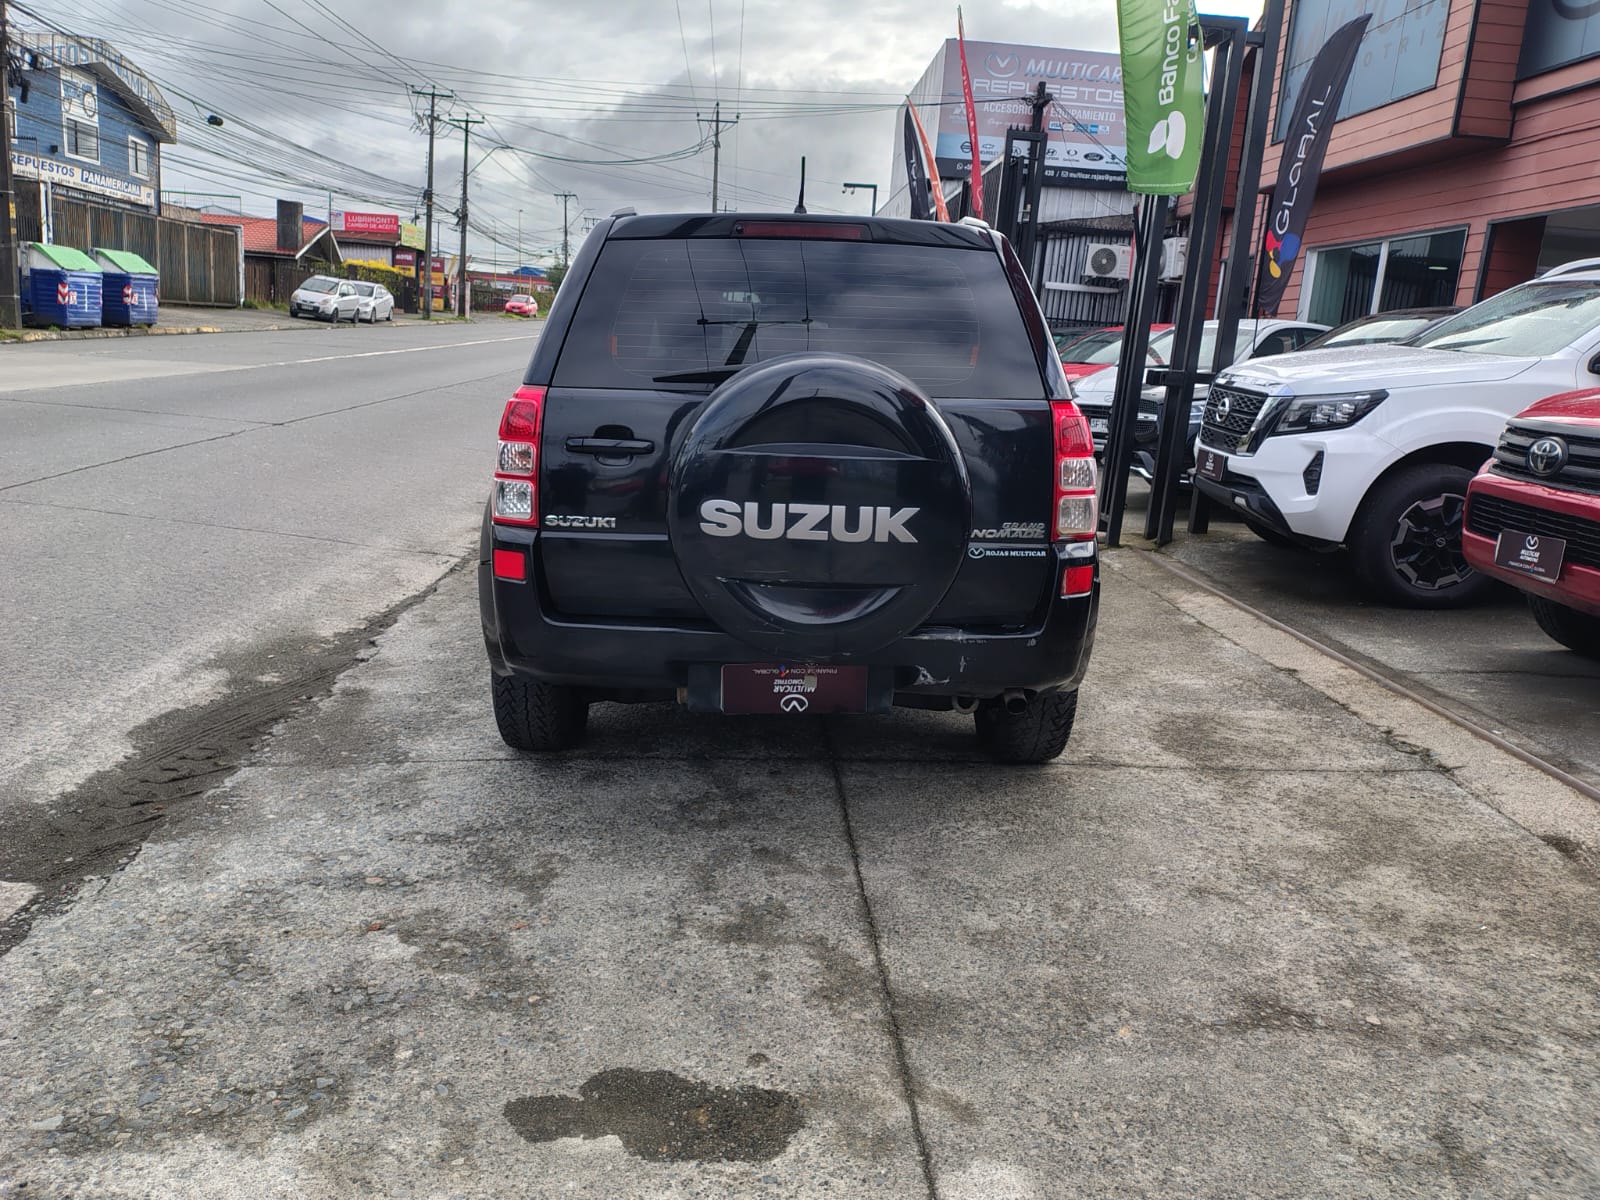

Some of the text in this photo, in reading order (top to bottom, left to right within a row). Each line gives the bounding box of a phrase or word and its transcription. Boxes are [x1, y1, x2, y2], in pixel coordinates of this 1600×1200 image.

[1024, 58, 1122, 84] MULTICAR
[984, 101, 1037, 116] ACCESORIO
[1051, 107, 1116, 122] EQUIPAMIENTO
[1275, 85, 1332, 235] GLOBAL
[11, 155, 75, 178] REPUESTOS
[82, 169, 140, 196] PANAMERICANA
[544, 514, 617, 529] SUZUKI
[699, 499, 921, 544] SUZUK
[969, 528, 1046, 539] NOMADE
[773, 685, 816, 693] MULTICAR
